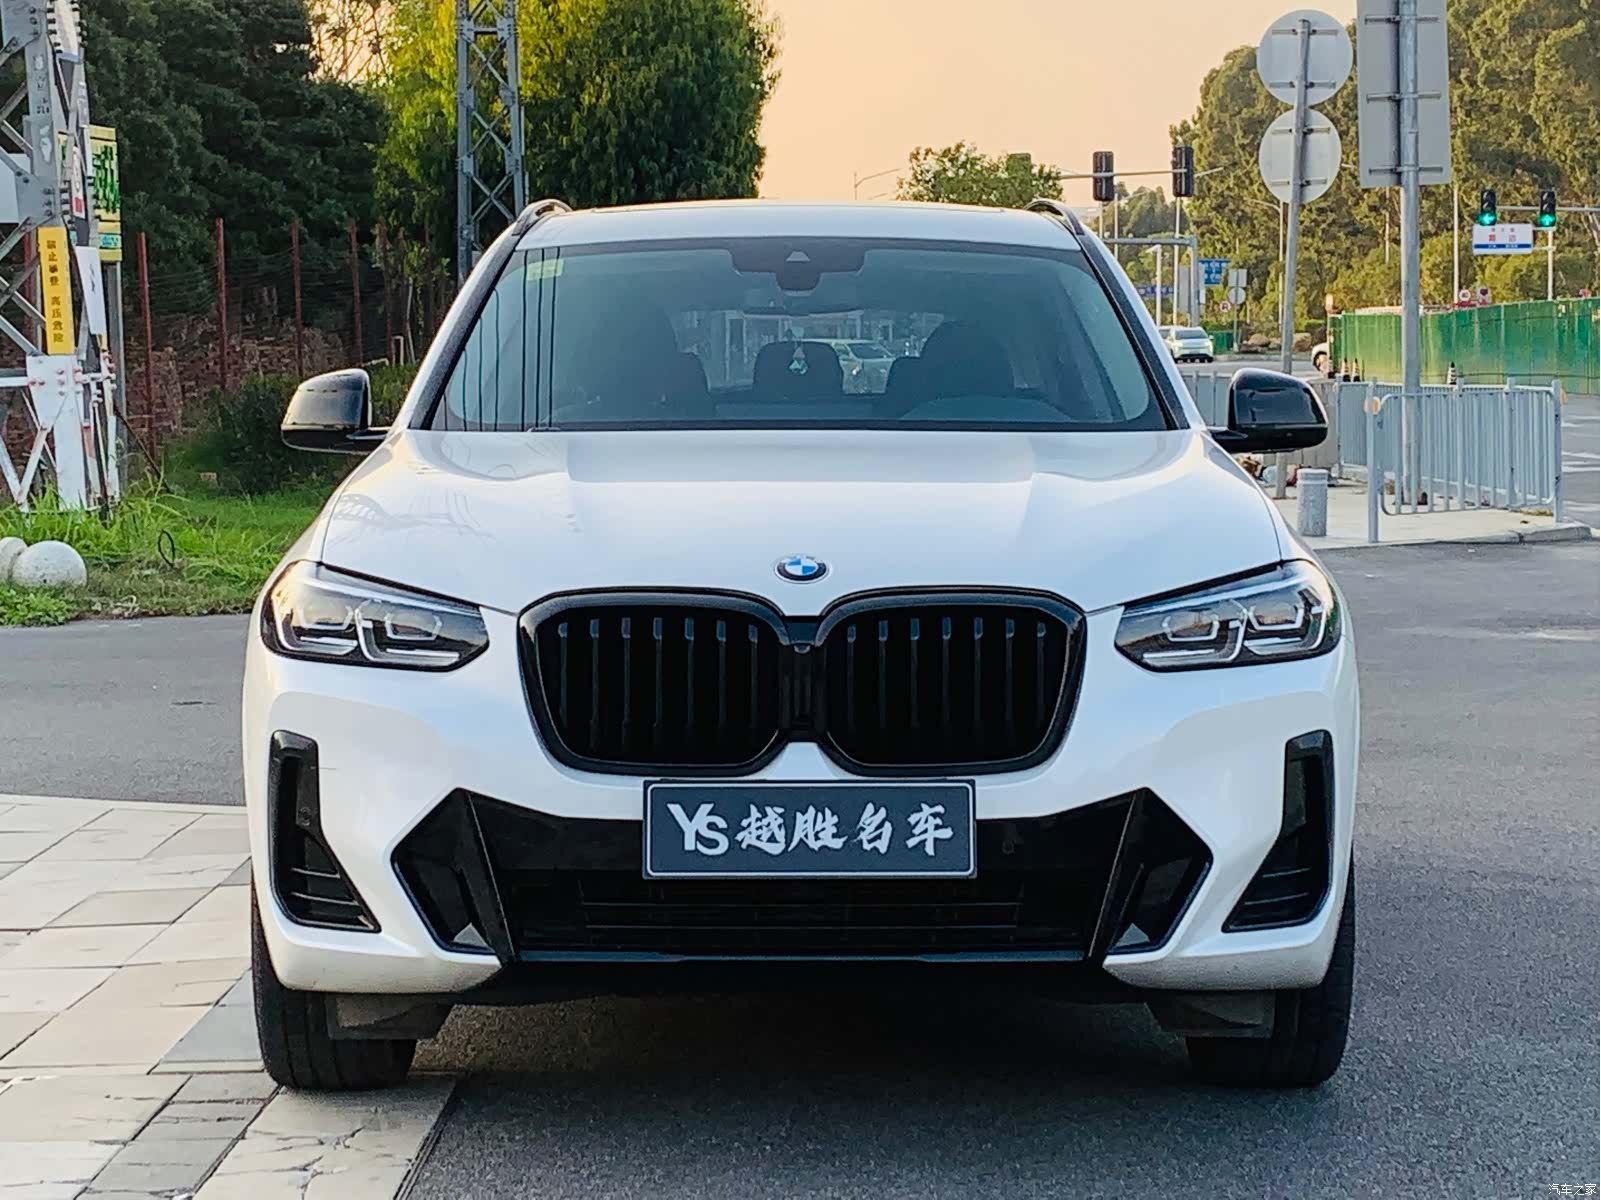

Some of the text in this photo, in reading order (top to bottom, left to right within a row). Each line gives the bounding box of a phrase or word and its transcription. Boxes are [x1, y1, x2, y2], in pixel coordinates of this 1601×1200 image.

[666, 802, 953, 857] YS 越胜名车
